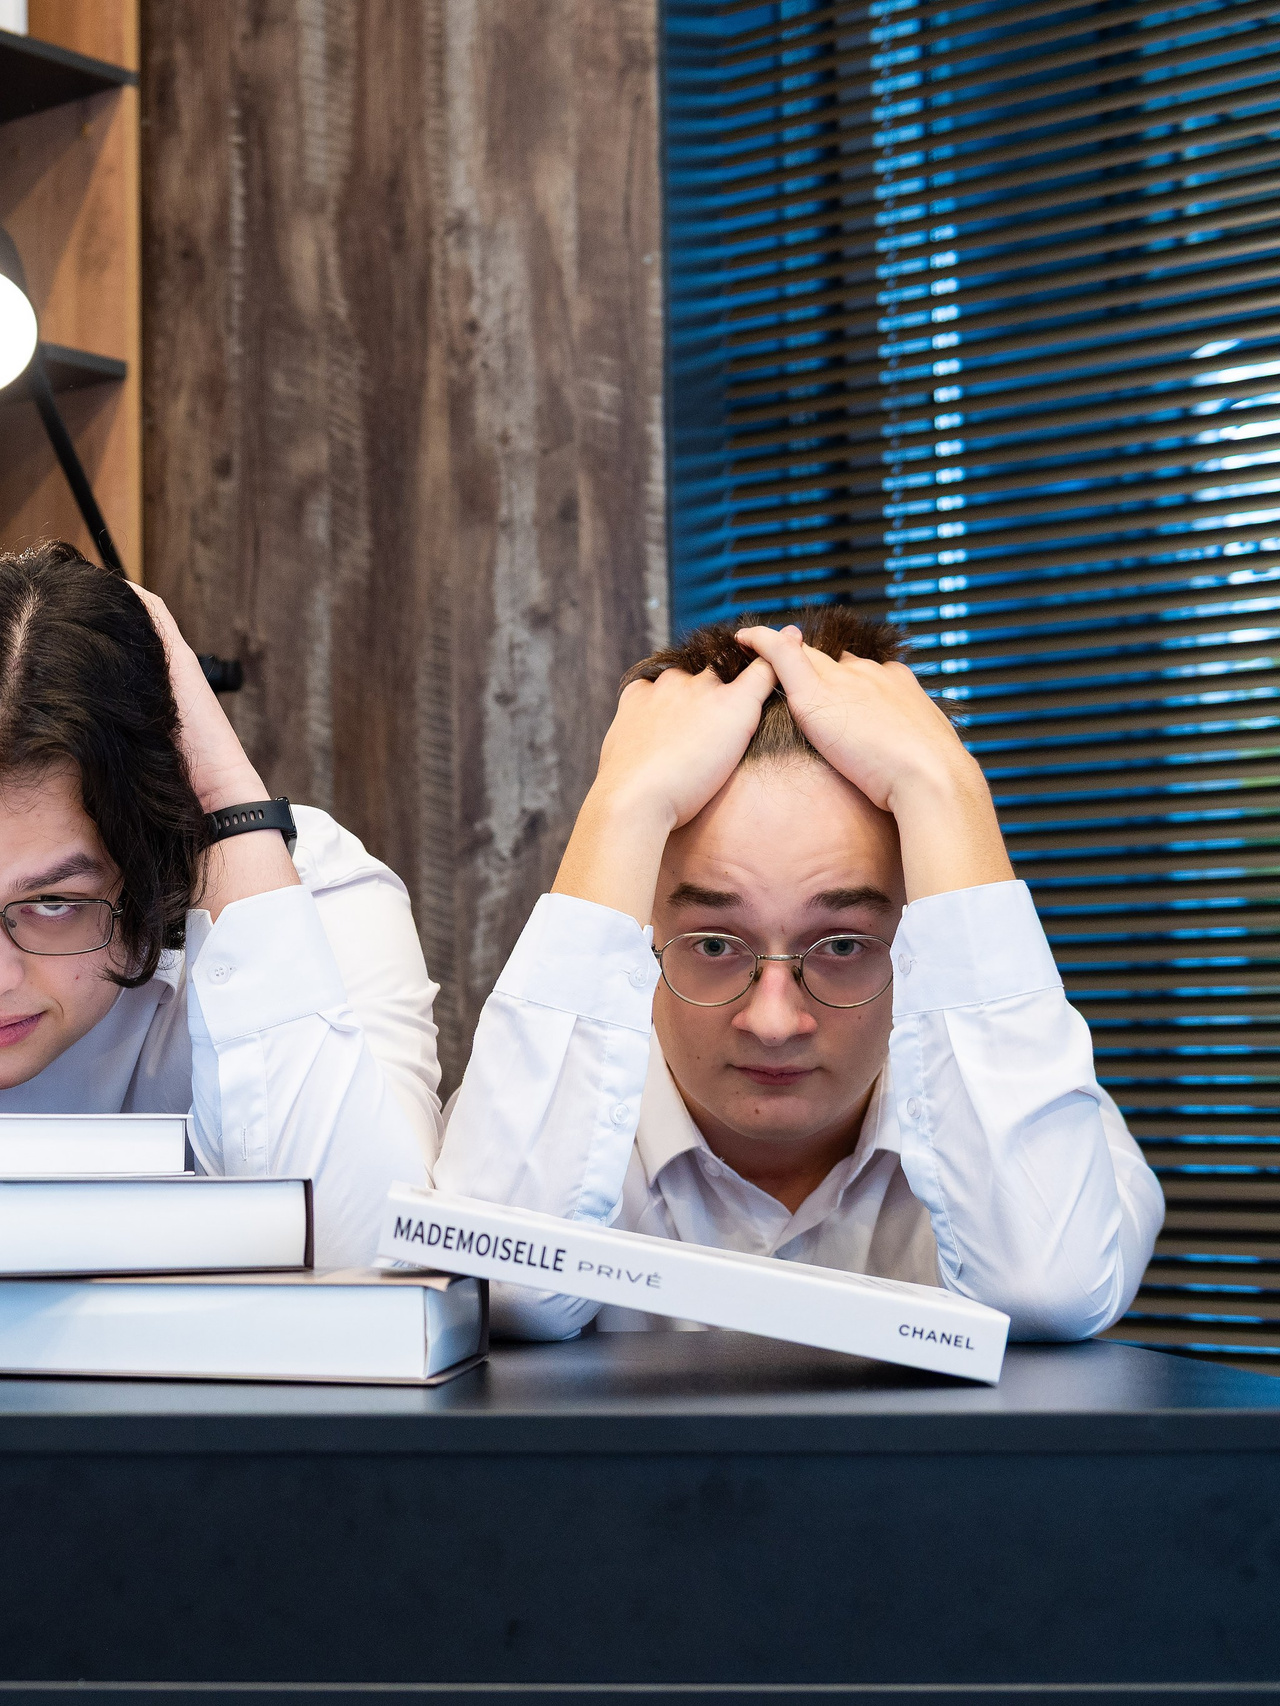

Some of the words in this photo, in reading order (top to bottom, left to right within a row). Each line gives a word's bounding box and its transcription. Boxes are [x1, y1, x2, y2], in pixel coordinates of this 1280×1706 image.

[393, 1215, 568, 1273] MADEMOISELLE
[577, 1260, 663, 1289] PRIVÉ
[898, 1323, 975, 1351] CHANEL
